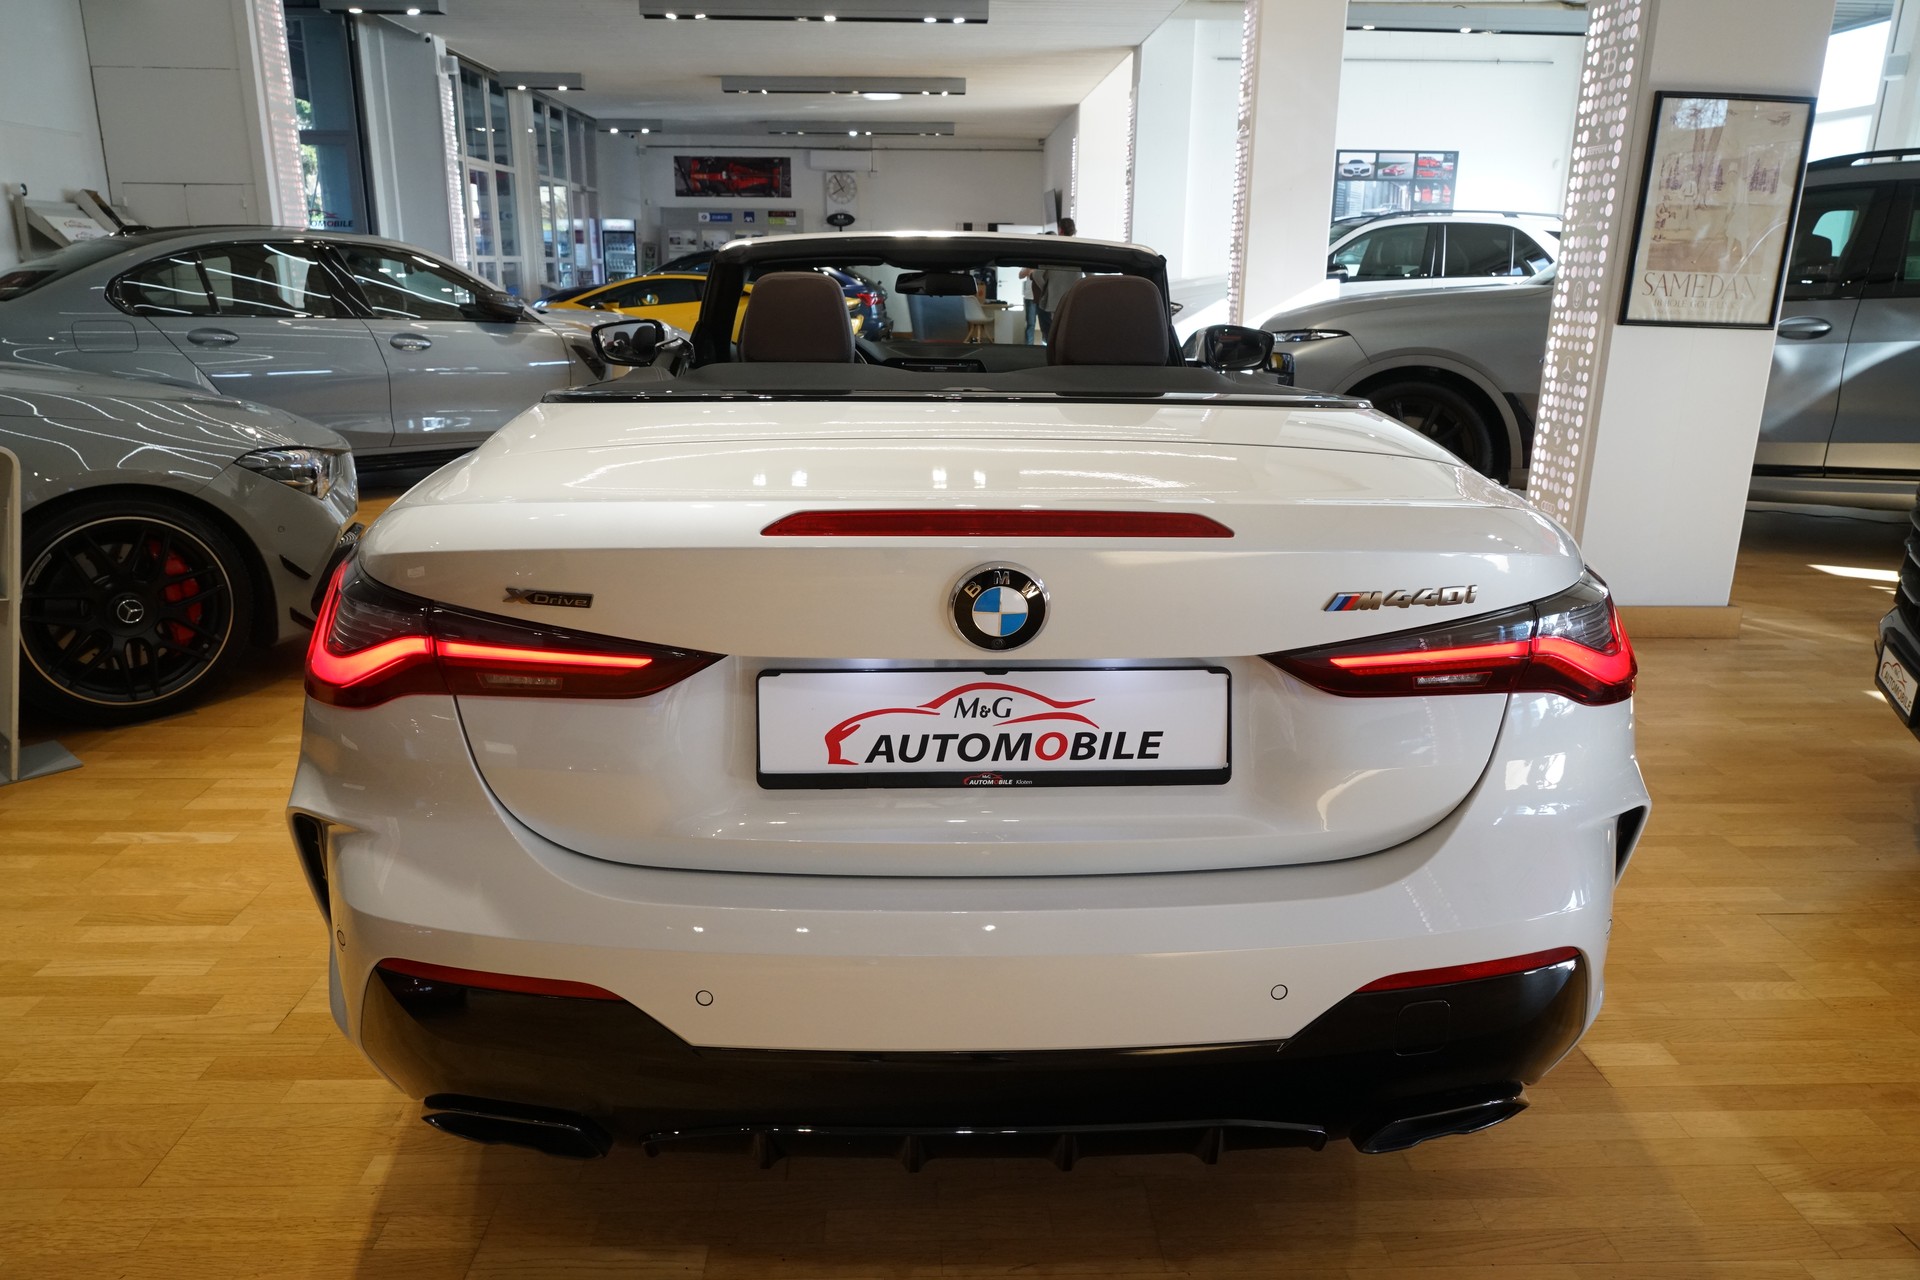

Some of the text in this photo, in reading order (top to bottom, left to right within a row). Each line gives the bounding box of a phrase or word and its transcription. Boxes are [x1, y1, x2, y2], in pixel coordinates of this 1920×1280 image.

[1642, 271, 1759, 300] SAMEDAN
[964, 570, 1040, 599] BMW
[1345, 584, 1478, 611] M440i
[953, 696, 1014, 718] M&G
[865, 731, 1164, 763] AUTOMOBILE
